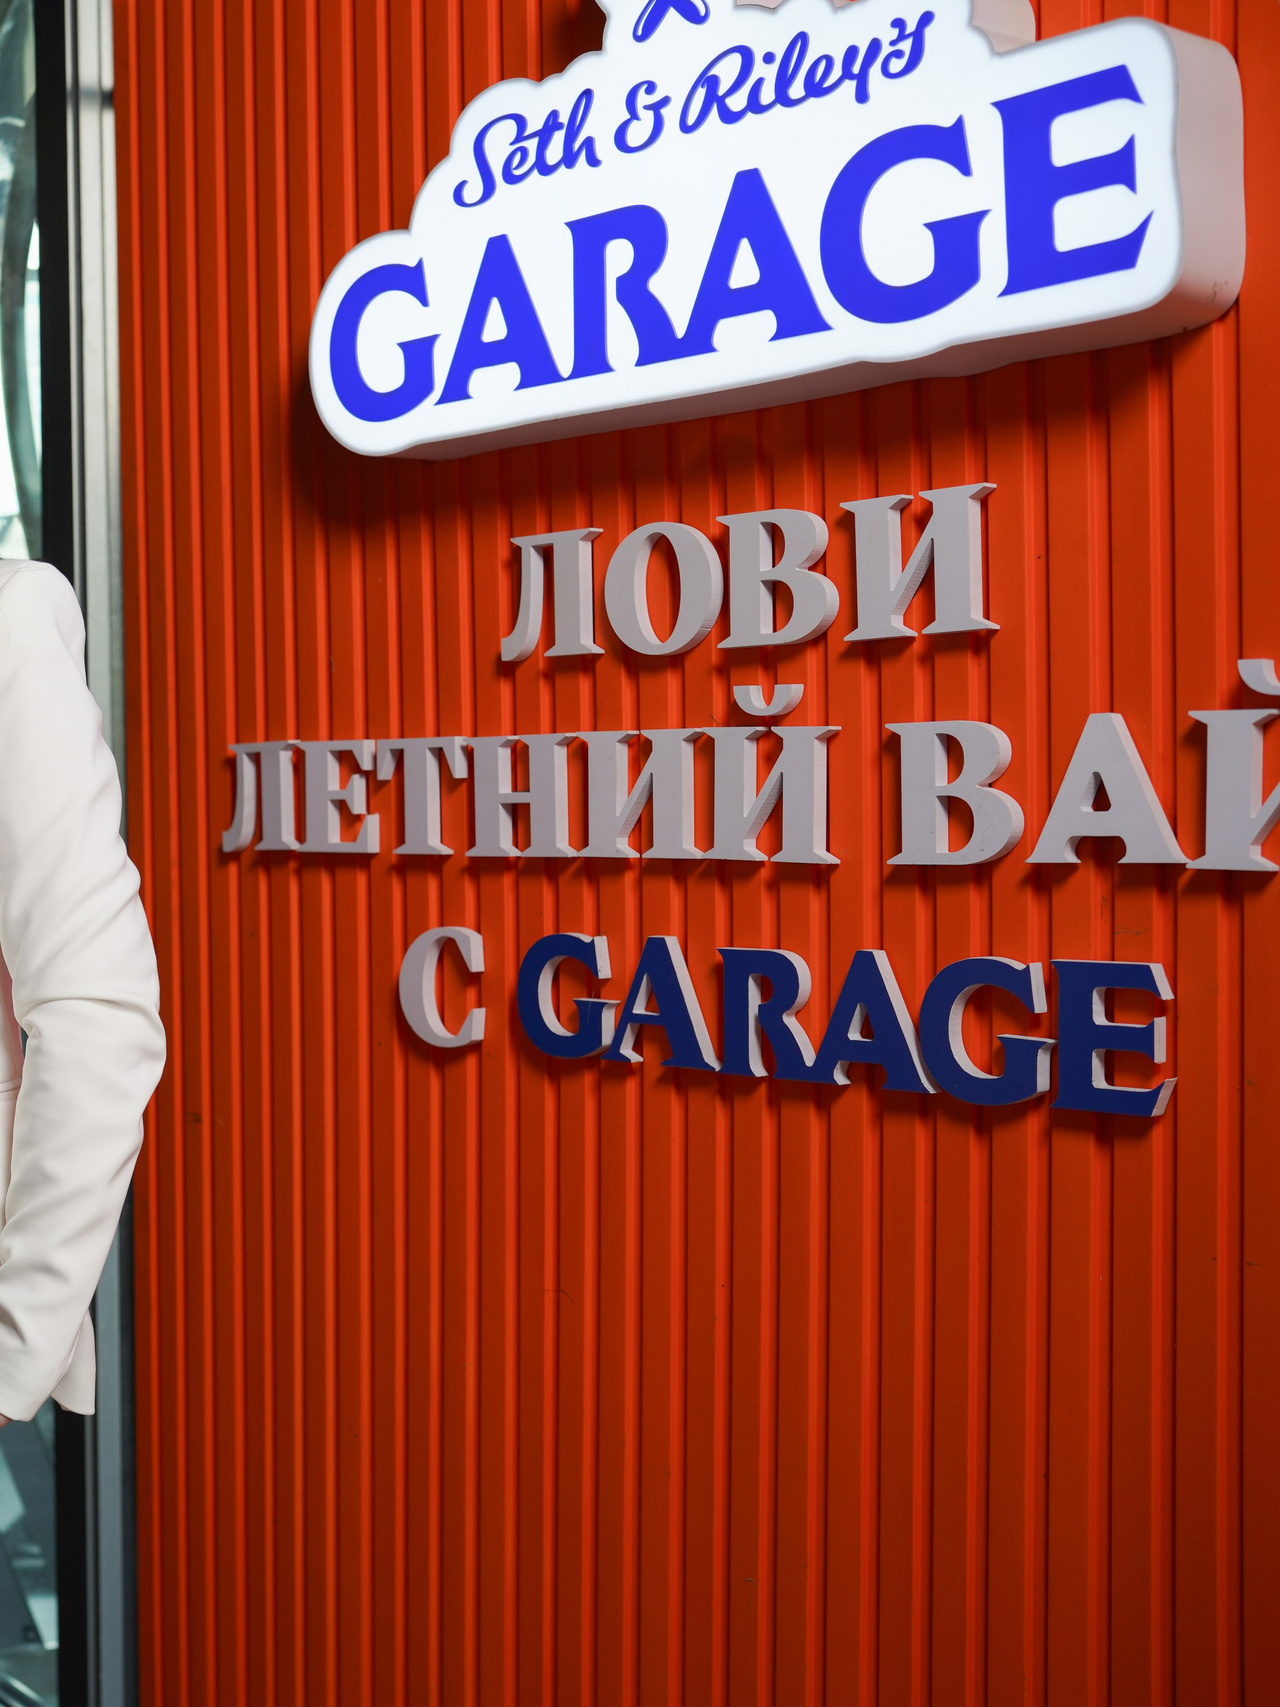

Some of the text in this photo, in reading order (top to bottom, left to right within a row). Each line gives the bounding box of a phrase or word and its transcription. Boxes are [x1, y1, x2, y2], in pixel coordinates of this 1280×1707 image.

[453, 10, 935, 208] Seth & Riley's
[329, 64, 1156, 424] GARAGE
[501, 482, 1000, 661] ЛОВИ
[223, 684, 842, 865] ЛЕТНИЙ
[399, 926, 1177, 1117] С GARAGE
